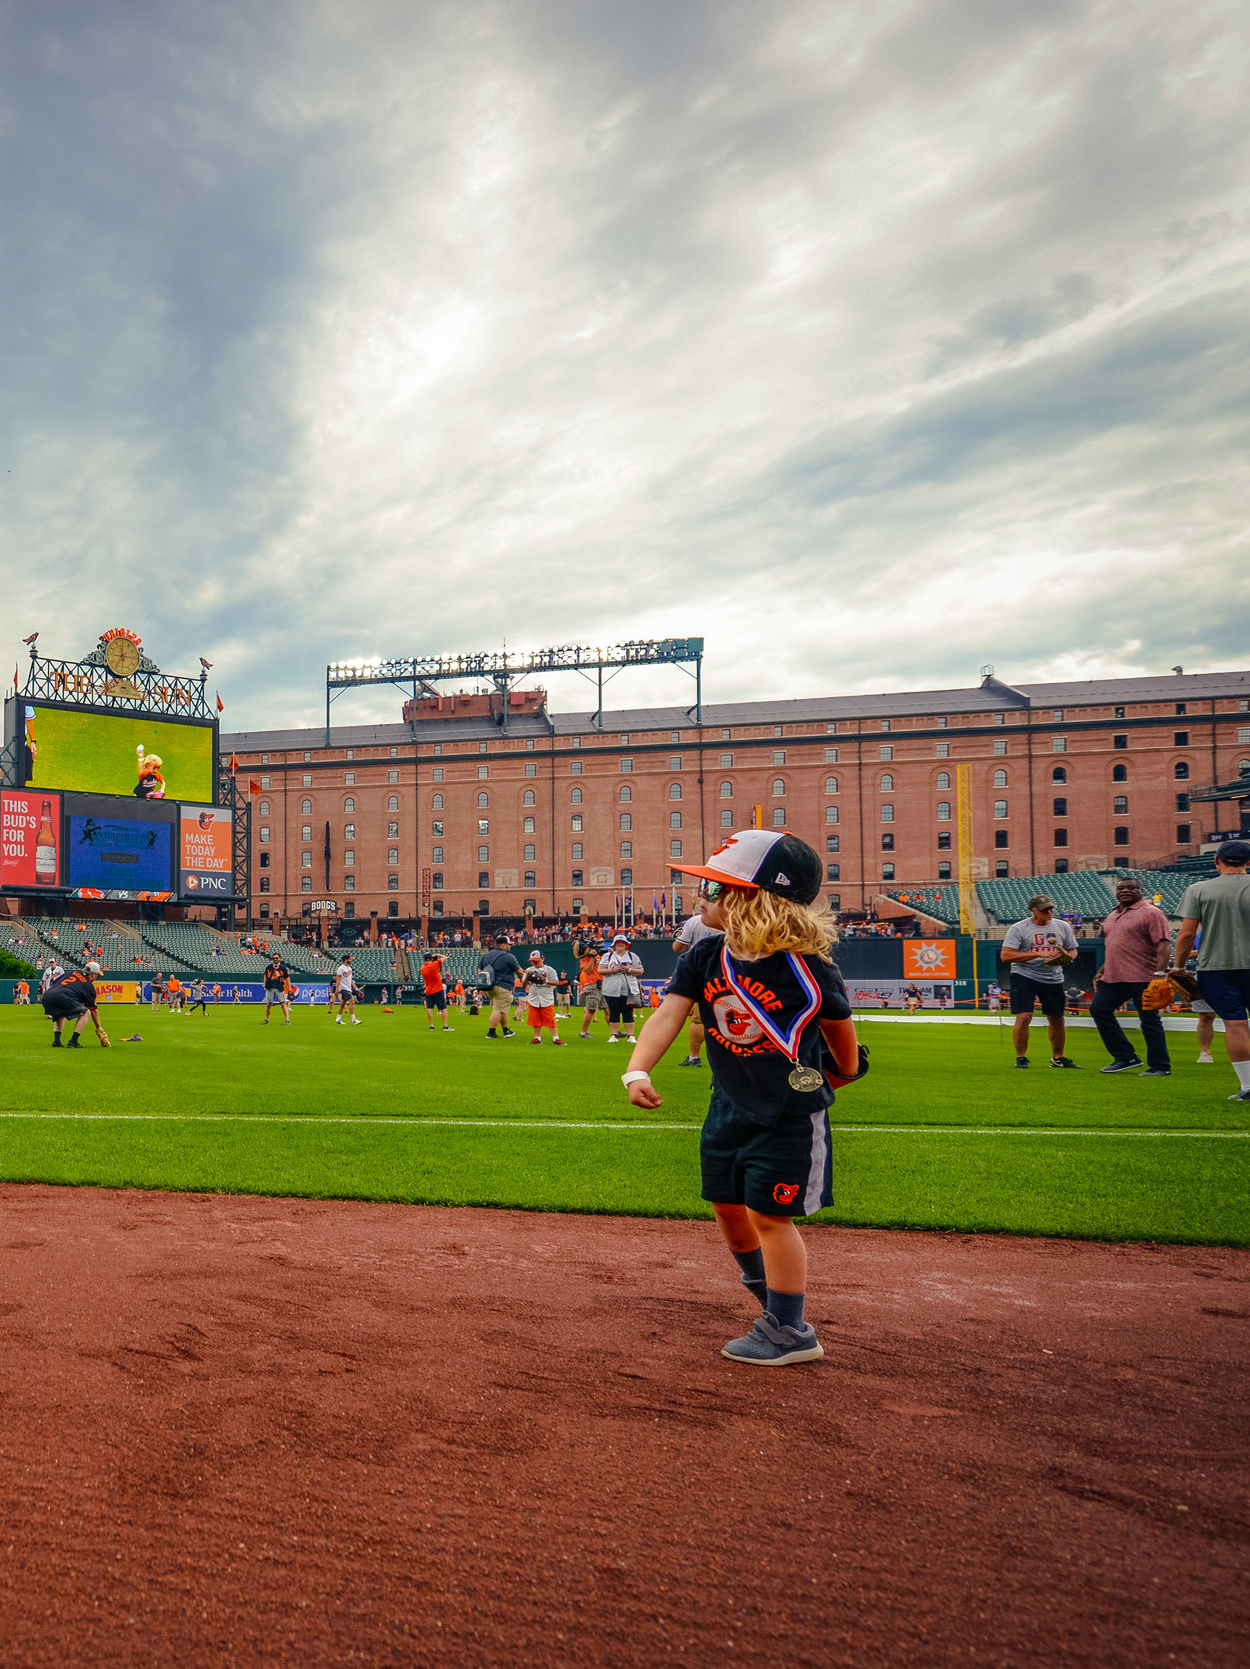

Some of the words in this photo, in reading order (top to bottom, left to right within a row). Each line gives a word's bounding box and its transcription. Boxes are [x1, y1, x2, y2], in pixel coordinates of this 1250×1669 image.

[50, 671, 93, 695] THE
[153, 684, 192, 707] SUN
[2, 799, 29, 814] THIS
[2, 813, 37, 829] BUD'S
[2, 829, 25, 842] FOR
[185, 833, 214, 845] MAKE
[2, 844, 29, 857] YOU.
[185, 844, 216, 857] TODAY
[185, 856, 205, 867] THE
[200, 876, 227, 890] PNC
[118, 890, 129, 899] VS
[301, 987, 329, 1000] ppsi
